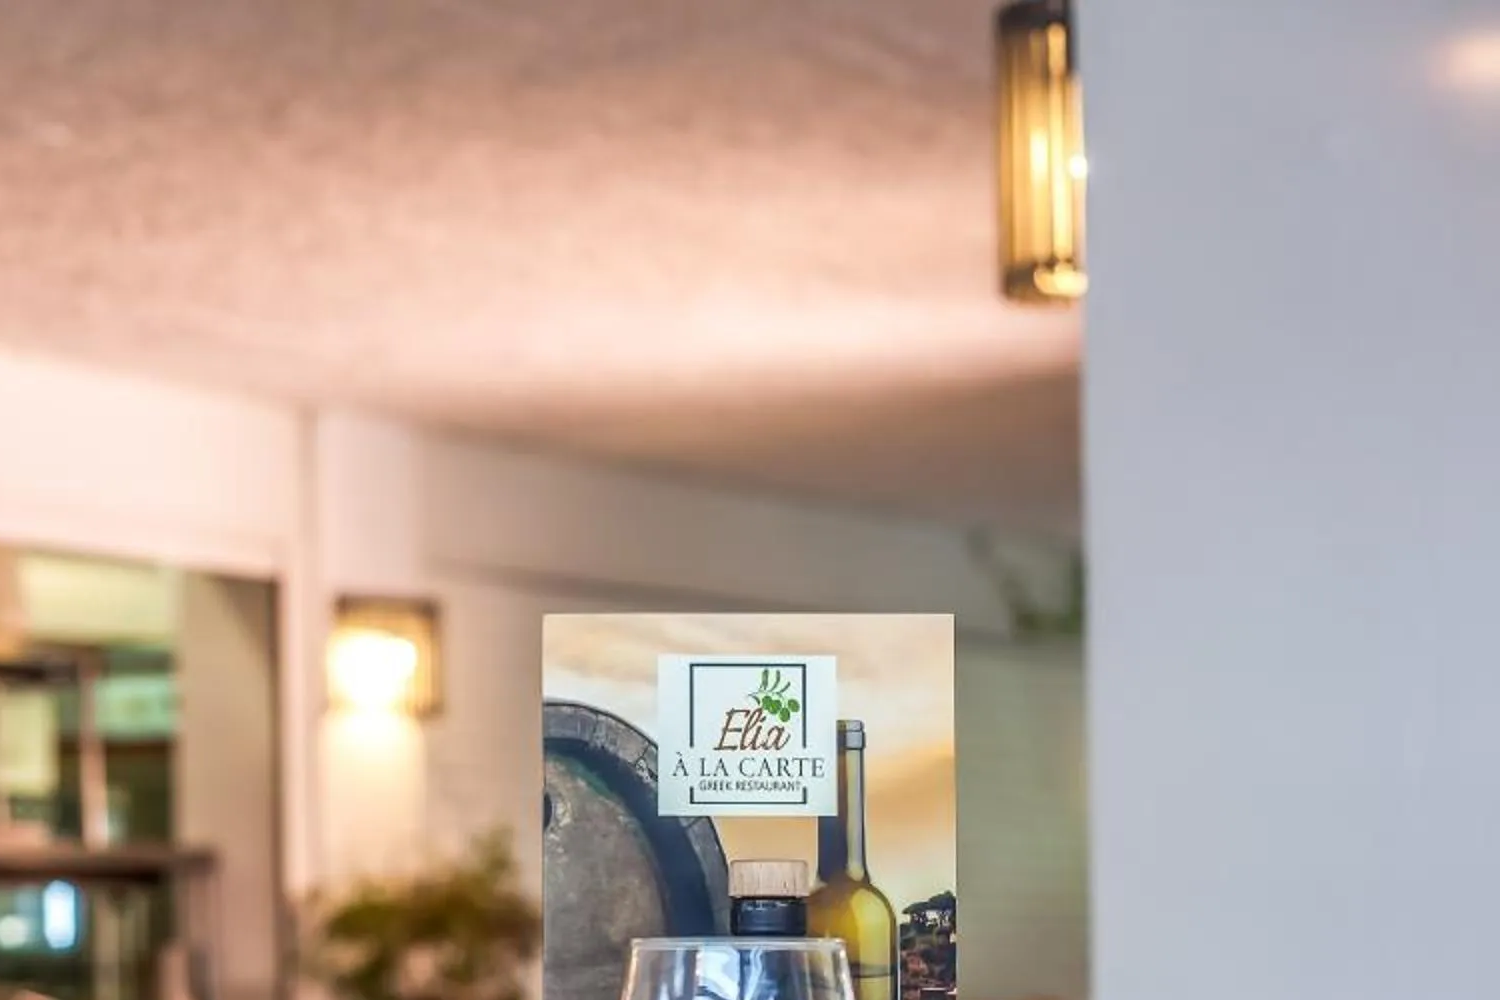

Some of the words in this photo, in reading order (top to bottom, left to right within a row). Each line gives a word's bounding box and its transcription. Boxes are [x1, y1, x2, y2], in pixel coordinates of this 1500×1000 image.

[672, 751, 689, 777] À
[699, 757, 729, 777] LA
[738, 757, 826, 778] CARTE
[699, 779, 732, 792] GREEK
[735, 779, 801, 792] RESTAURANT
